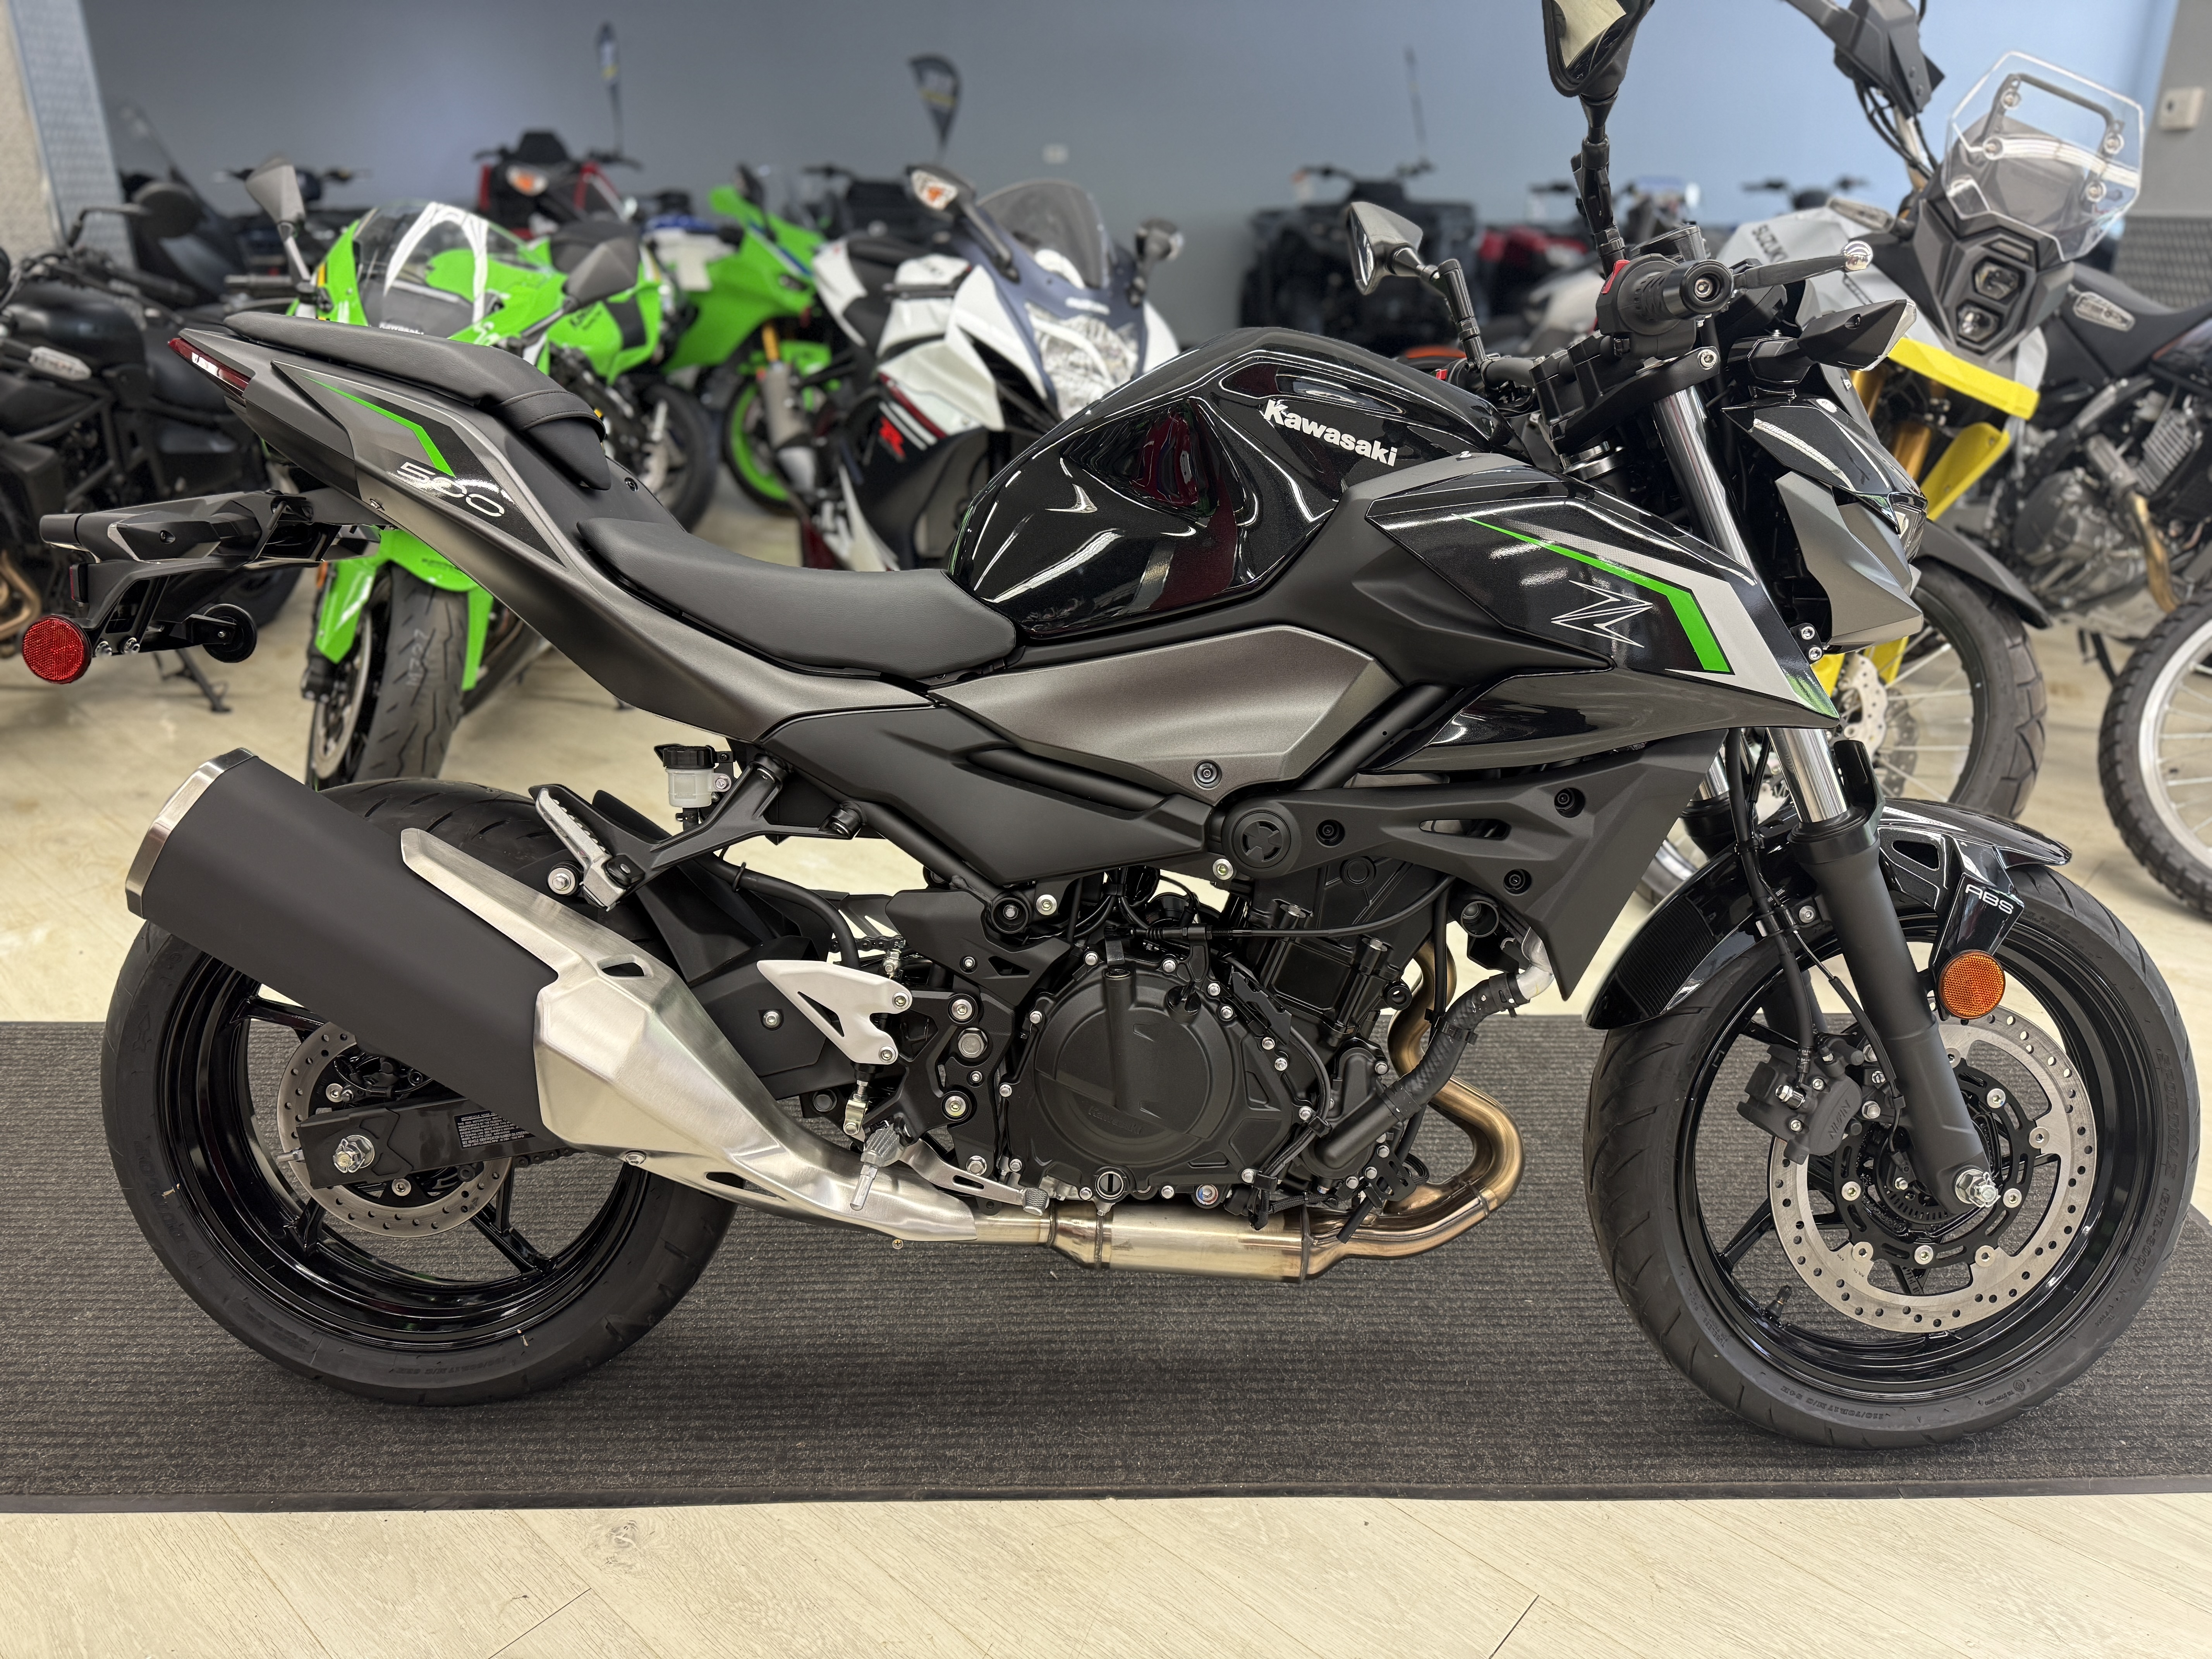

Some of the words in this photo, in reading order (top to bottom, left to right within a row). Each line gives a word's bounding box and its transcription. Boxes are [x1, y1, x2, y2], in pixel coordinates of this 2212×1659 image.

[1264, 399, 1398, 467] Kawasaki
[397, 462, 505, 517] 500
[1965, 884, 2014, 914] ABS
[1088, 1106, 1143, 1135] Kawasaki
[1828, 1099, 1851, 1140] NISSIN
[1703, 1317, 1726, 1348] TUBELESS
[1780, 1385, 1803, 1400] 54H
[1805, 1396, 1827, 1409] M/C
[1828, 1405, 1884, 1420] 110/70R17
